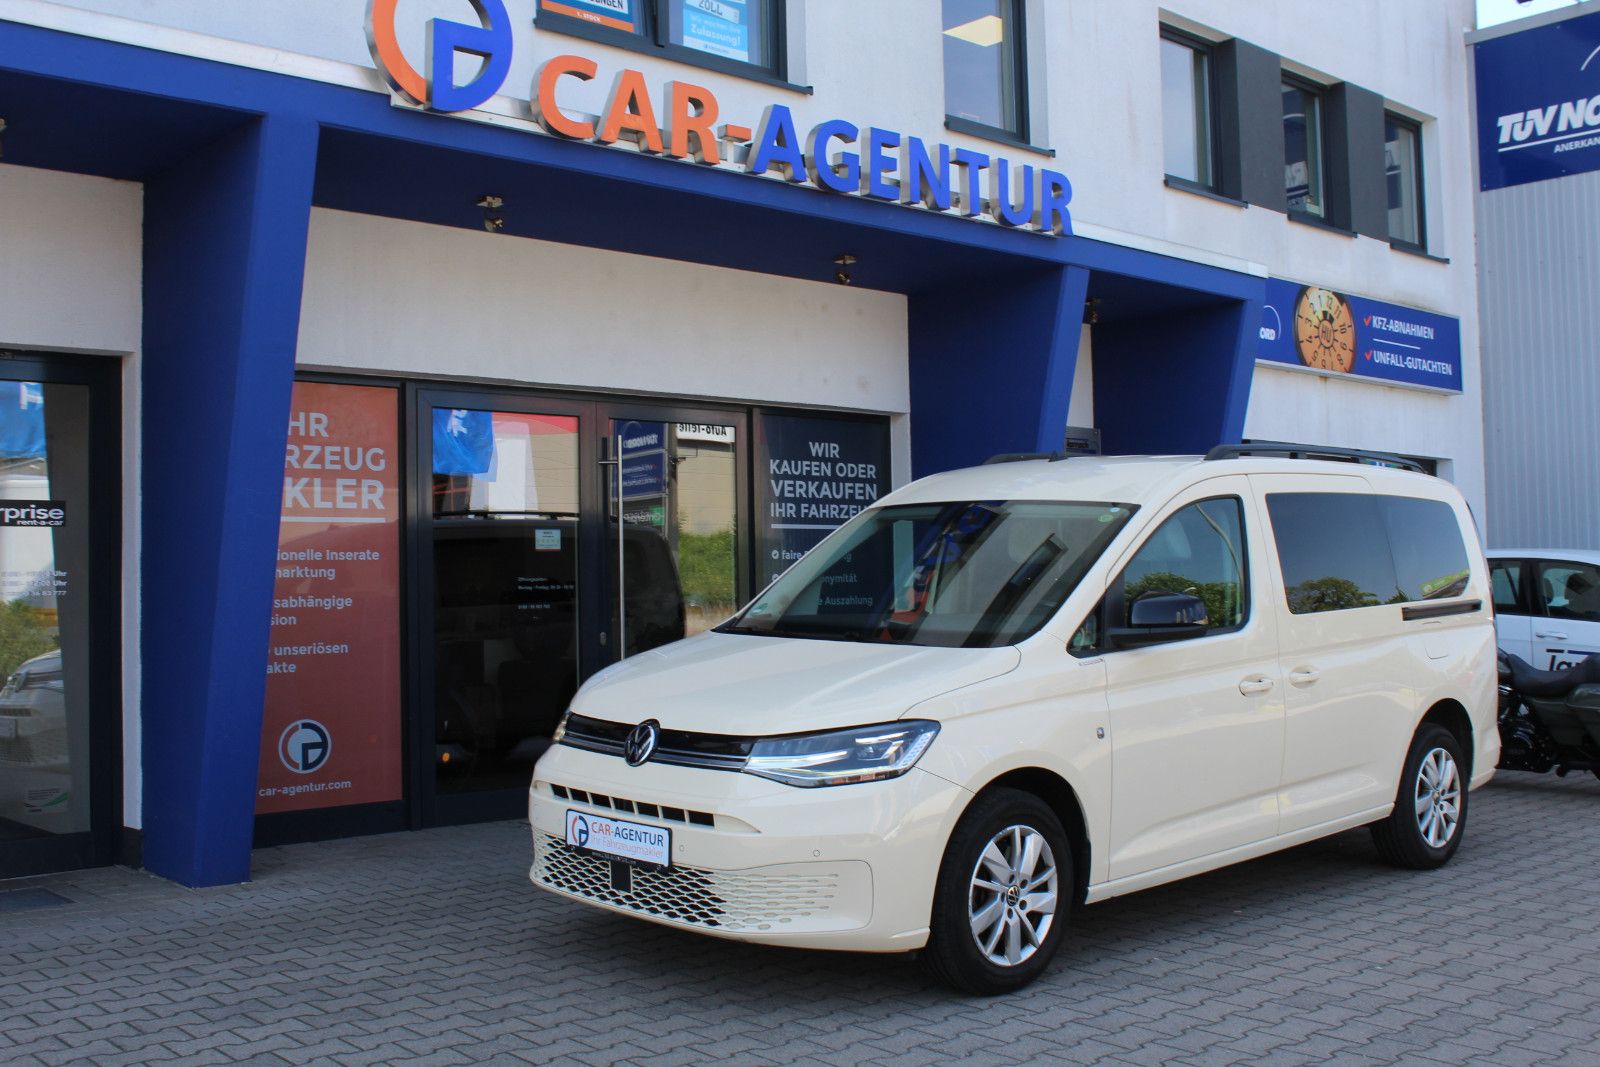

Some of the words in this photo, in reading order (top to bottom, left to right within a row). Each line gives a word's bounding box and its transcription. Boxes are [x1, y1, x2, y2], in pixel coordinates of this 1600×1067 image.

[533, 55, 1073, 235] CAR-AGENTUR
[1372, 315, 1434, 340] KFZ-ABNAHMEN
[1373, 350, 1453, 376] UNFALL-GUTACHTEN
[285, 444, 386, 472] RZEUG
[809, 441, 840, 459] WIR
[770, 459, 831, 477] KAUFEN
[836, 463, 876, 479] ODER
[284, 476, 385, 510] KLER
[771, 480, 877, 500] VERKAUFEN
[771, 503, 796, 518] IHR
[326, 549, 380, 560] Inserate
[823, 573, 857, 584] nymität
[825, 596, 873, 607] Auszahlung
[274, 643, 349, 656] unseriösen
[258, 781, 352, 797] car-agentur.com
[591, 822, 664, 847] CAR-AGENTUR
